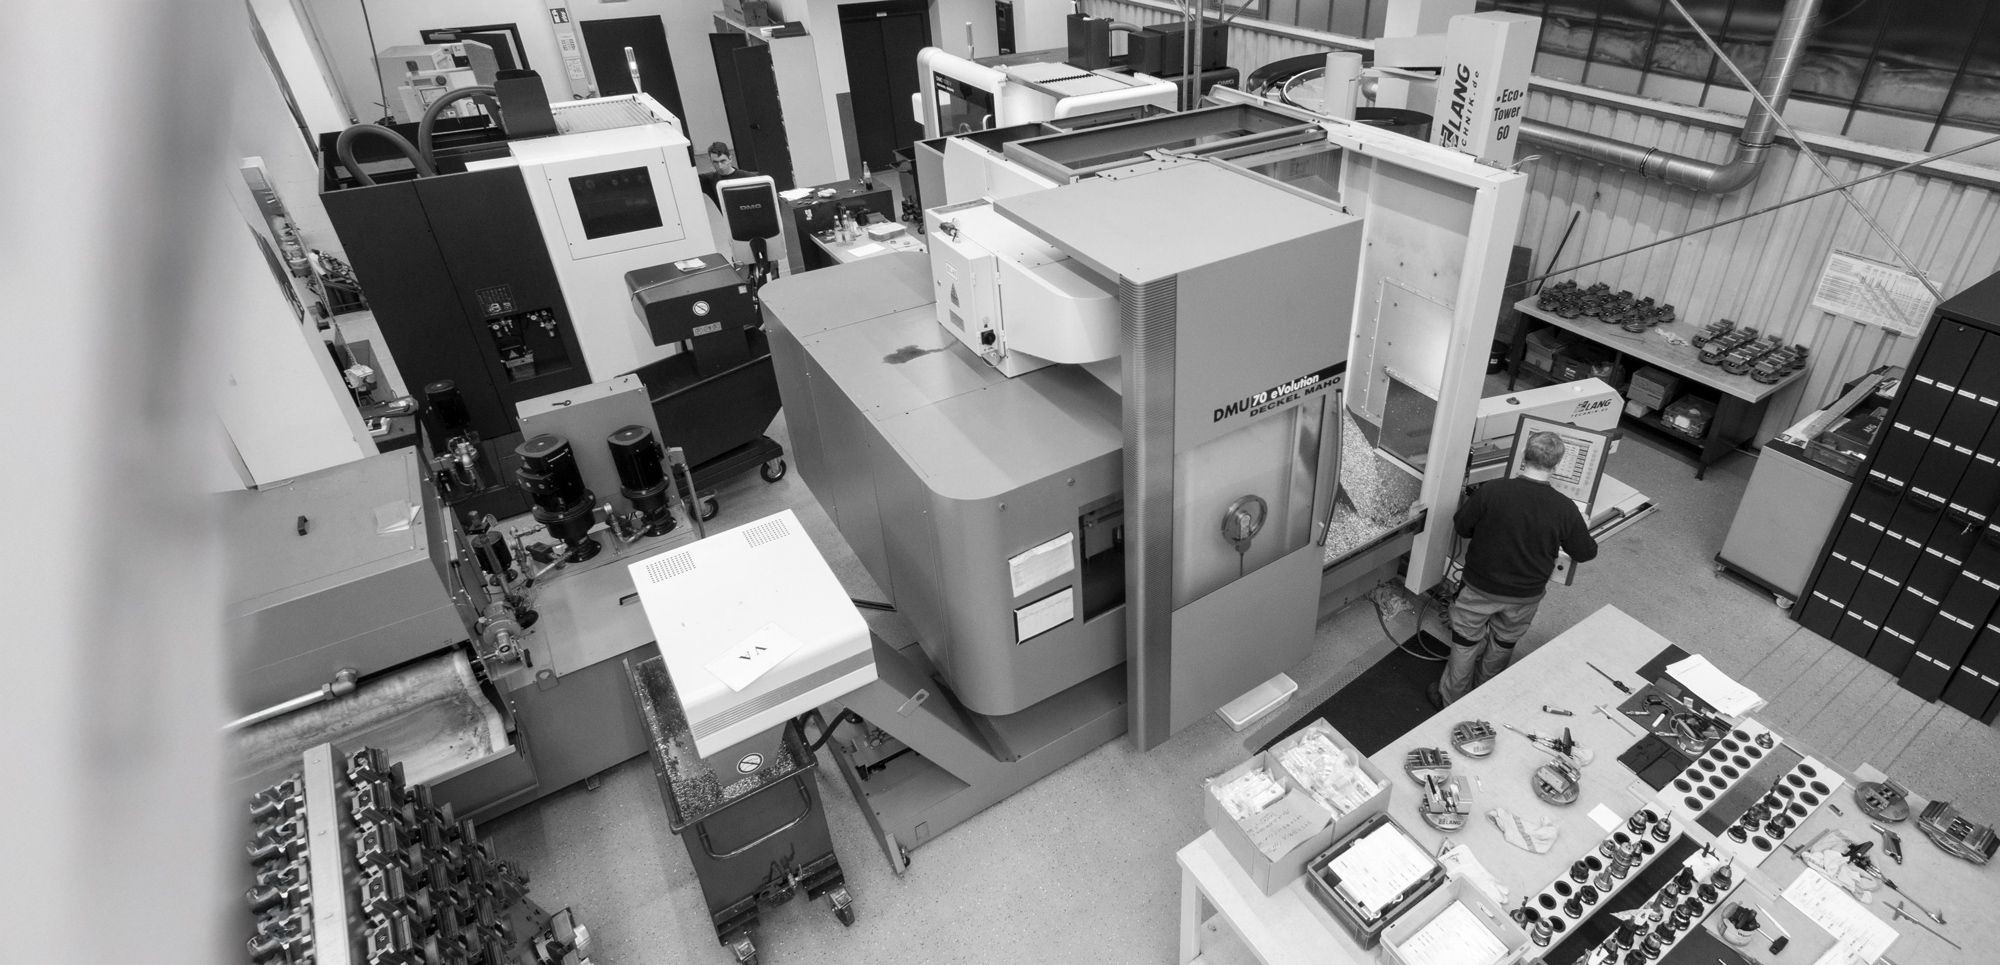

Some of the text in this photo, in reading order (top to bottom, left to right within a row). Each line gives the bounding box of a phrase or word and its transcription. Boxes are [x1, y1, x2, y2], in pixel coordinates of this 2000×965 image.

[1447, 63, 1471, 132] LANG
[1460, 70, 1480, 147] CHNIK.de
[1501, 88, 1520, 103] Eco
[1493, 106, 1522, 122] Tower
[1496, 124, 1511, 141] 60
[1213, 374, 1320, 423] DMU 70 eVolution
[1249, 376, 1341, 418] DECKEL MAHO
[1584, 398, 1612, 411] LANG
